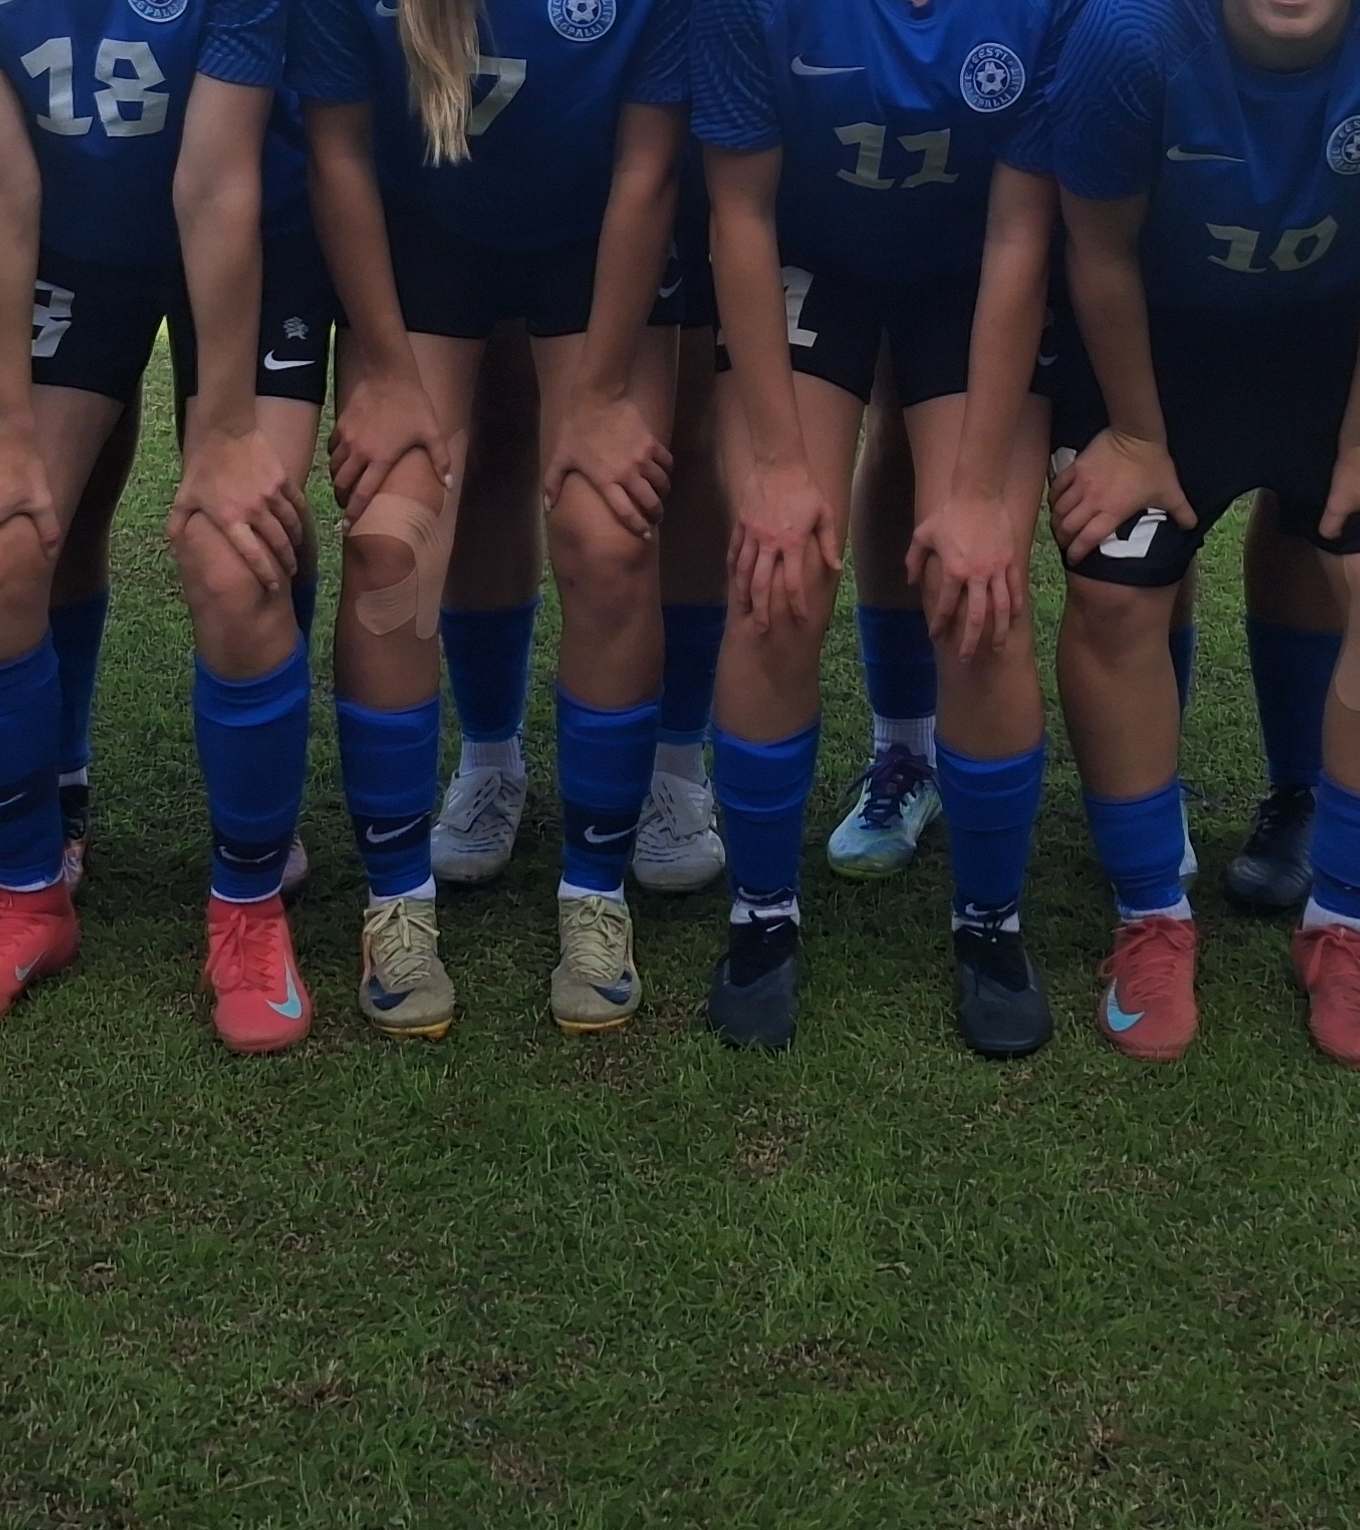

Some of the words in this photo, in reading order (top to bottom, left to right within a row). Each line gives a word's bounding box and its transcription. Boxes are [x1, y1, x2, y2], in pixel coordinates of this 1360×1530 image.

[20, 36, 170, 137] 18
[833, 121, 960, 190] 11
[1205, 214, 1339, 273] 10
